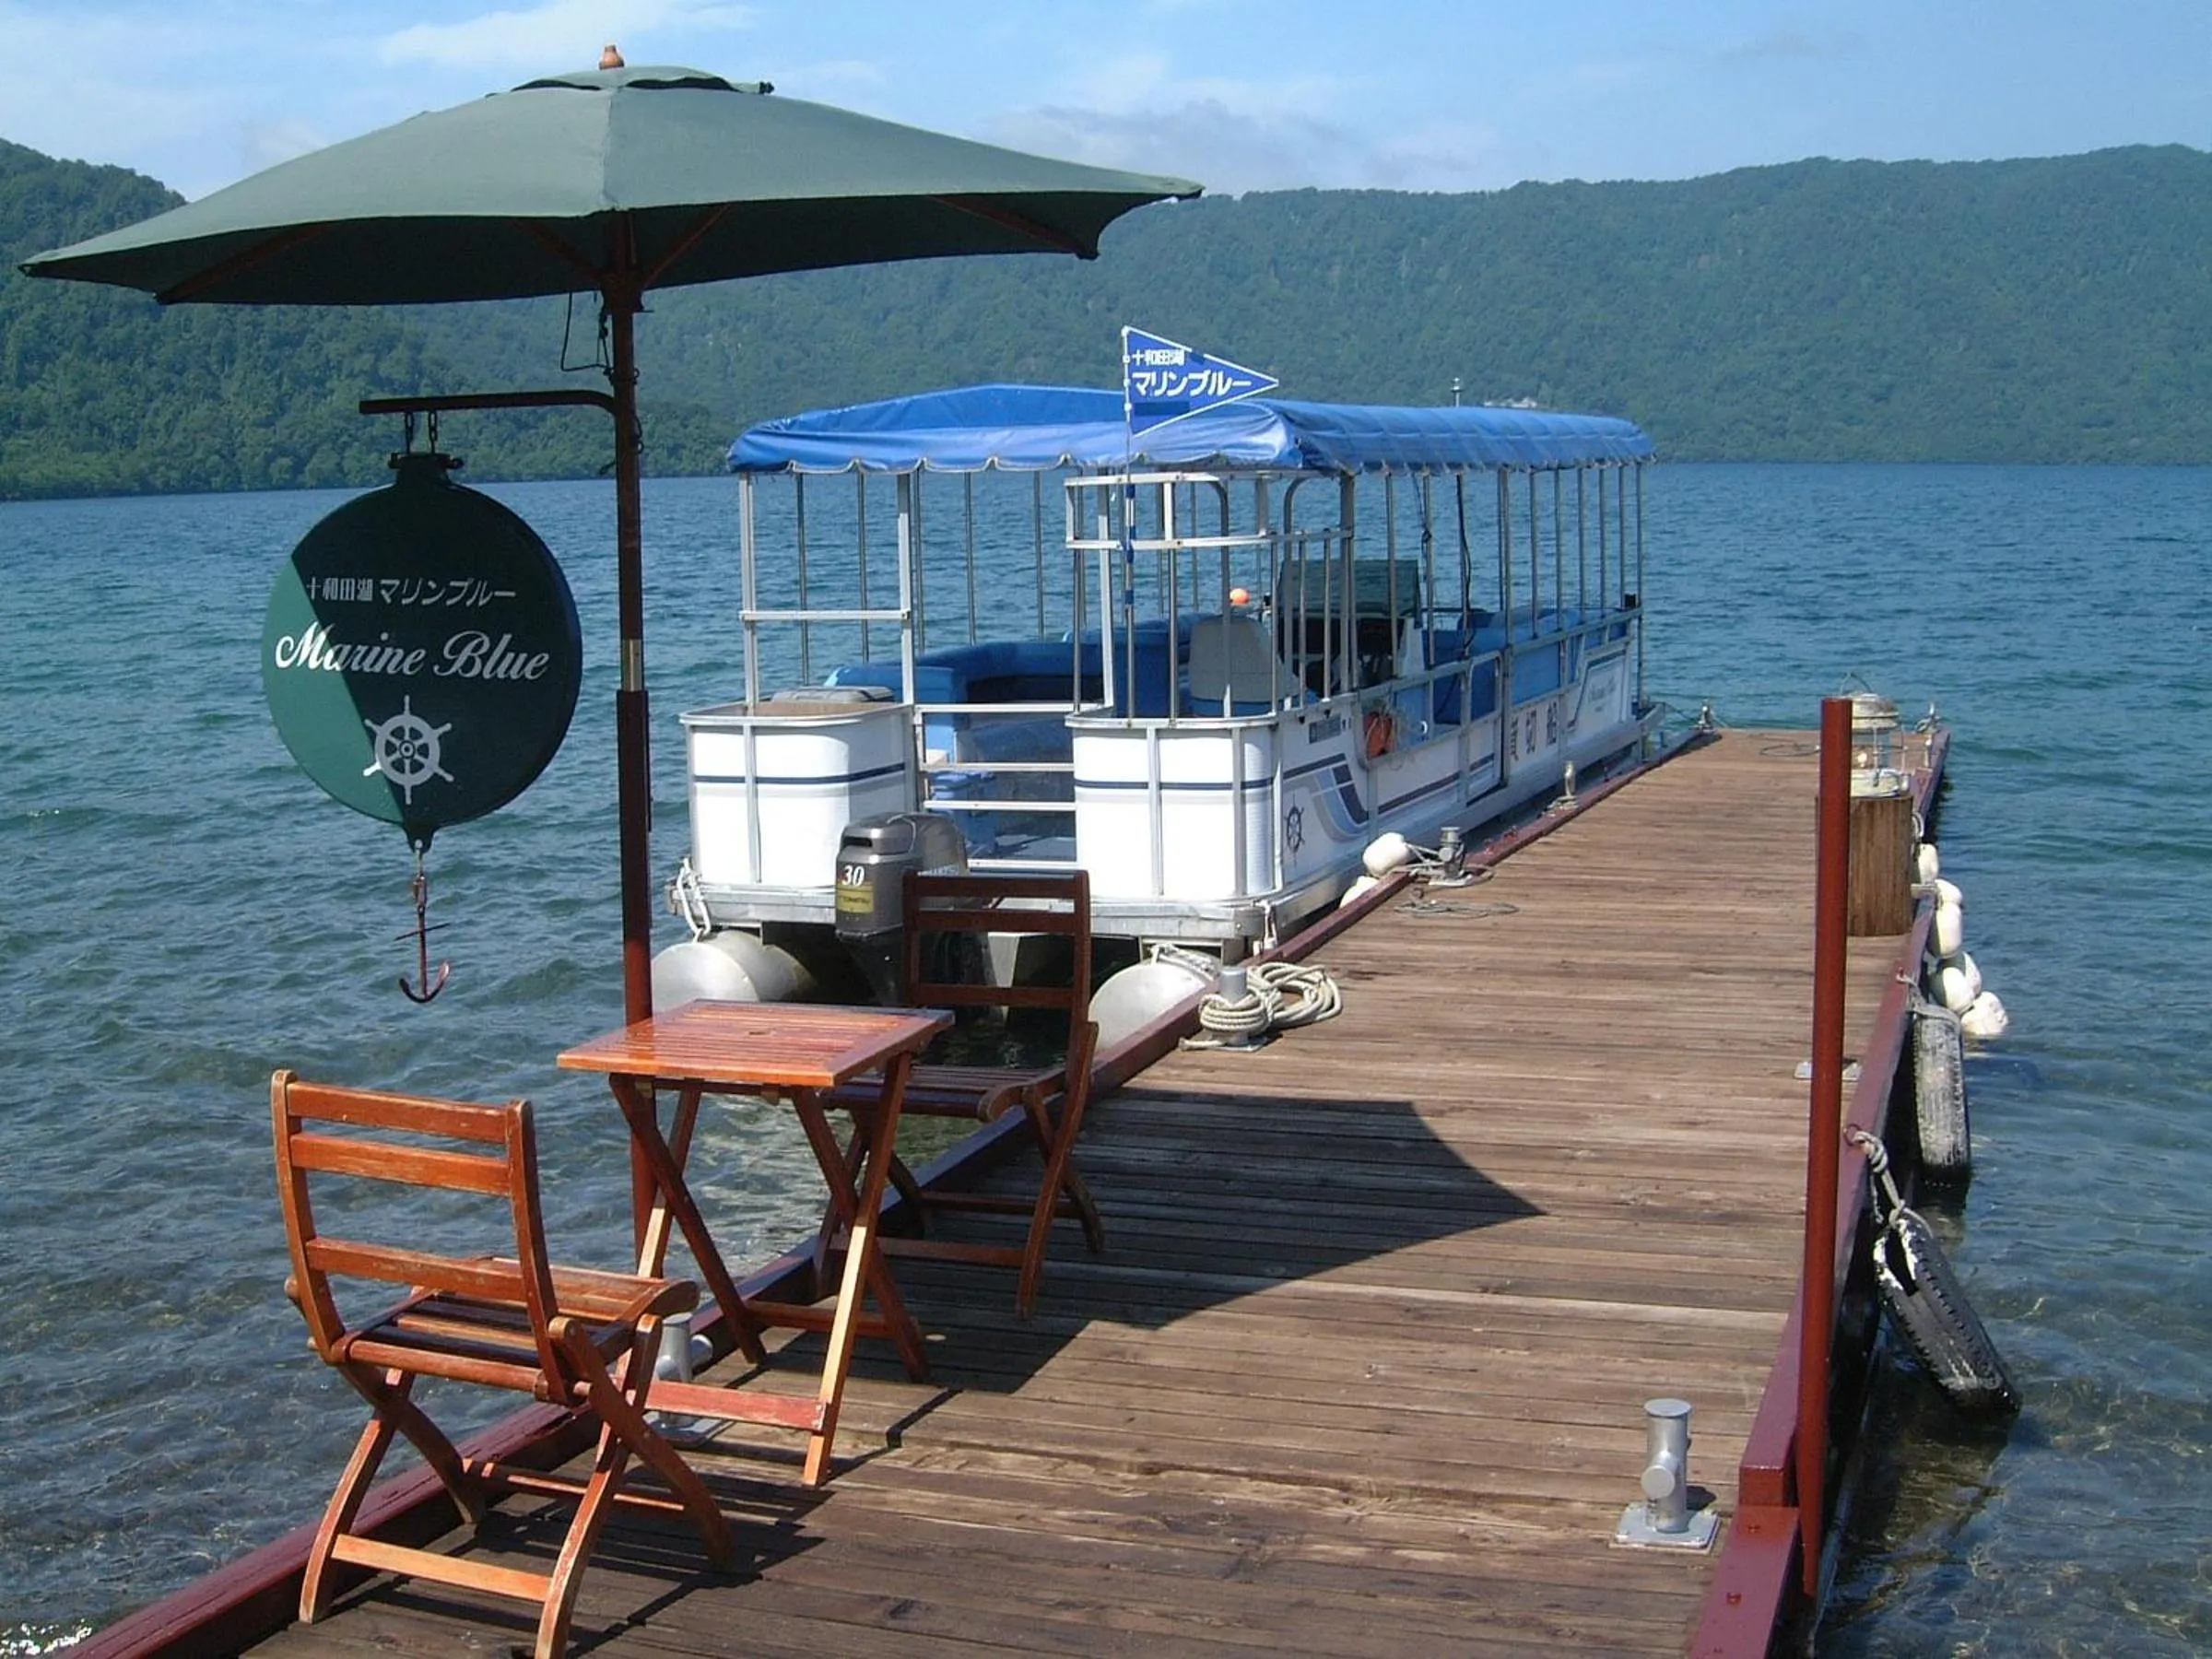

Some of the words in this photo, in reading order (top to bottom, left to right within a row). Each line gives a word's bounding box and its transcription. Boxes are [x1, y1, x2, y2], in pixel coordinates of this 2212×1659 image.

[1132, 370, 1252, 396] マリンブルー
[275, 620, 427, 676] Marine
[433, 629, 550, 680] Blue
[841, 865, 865, 887] 30
